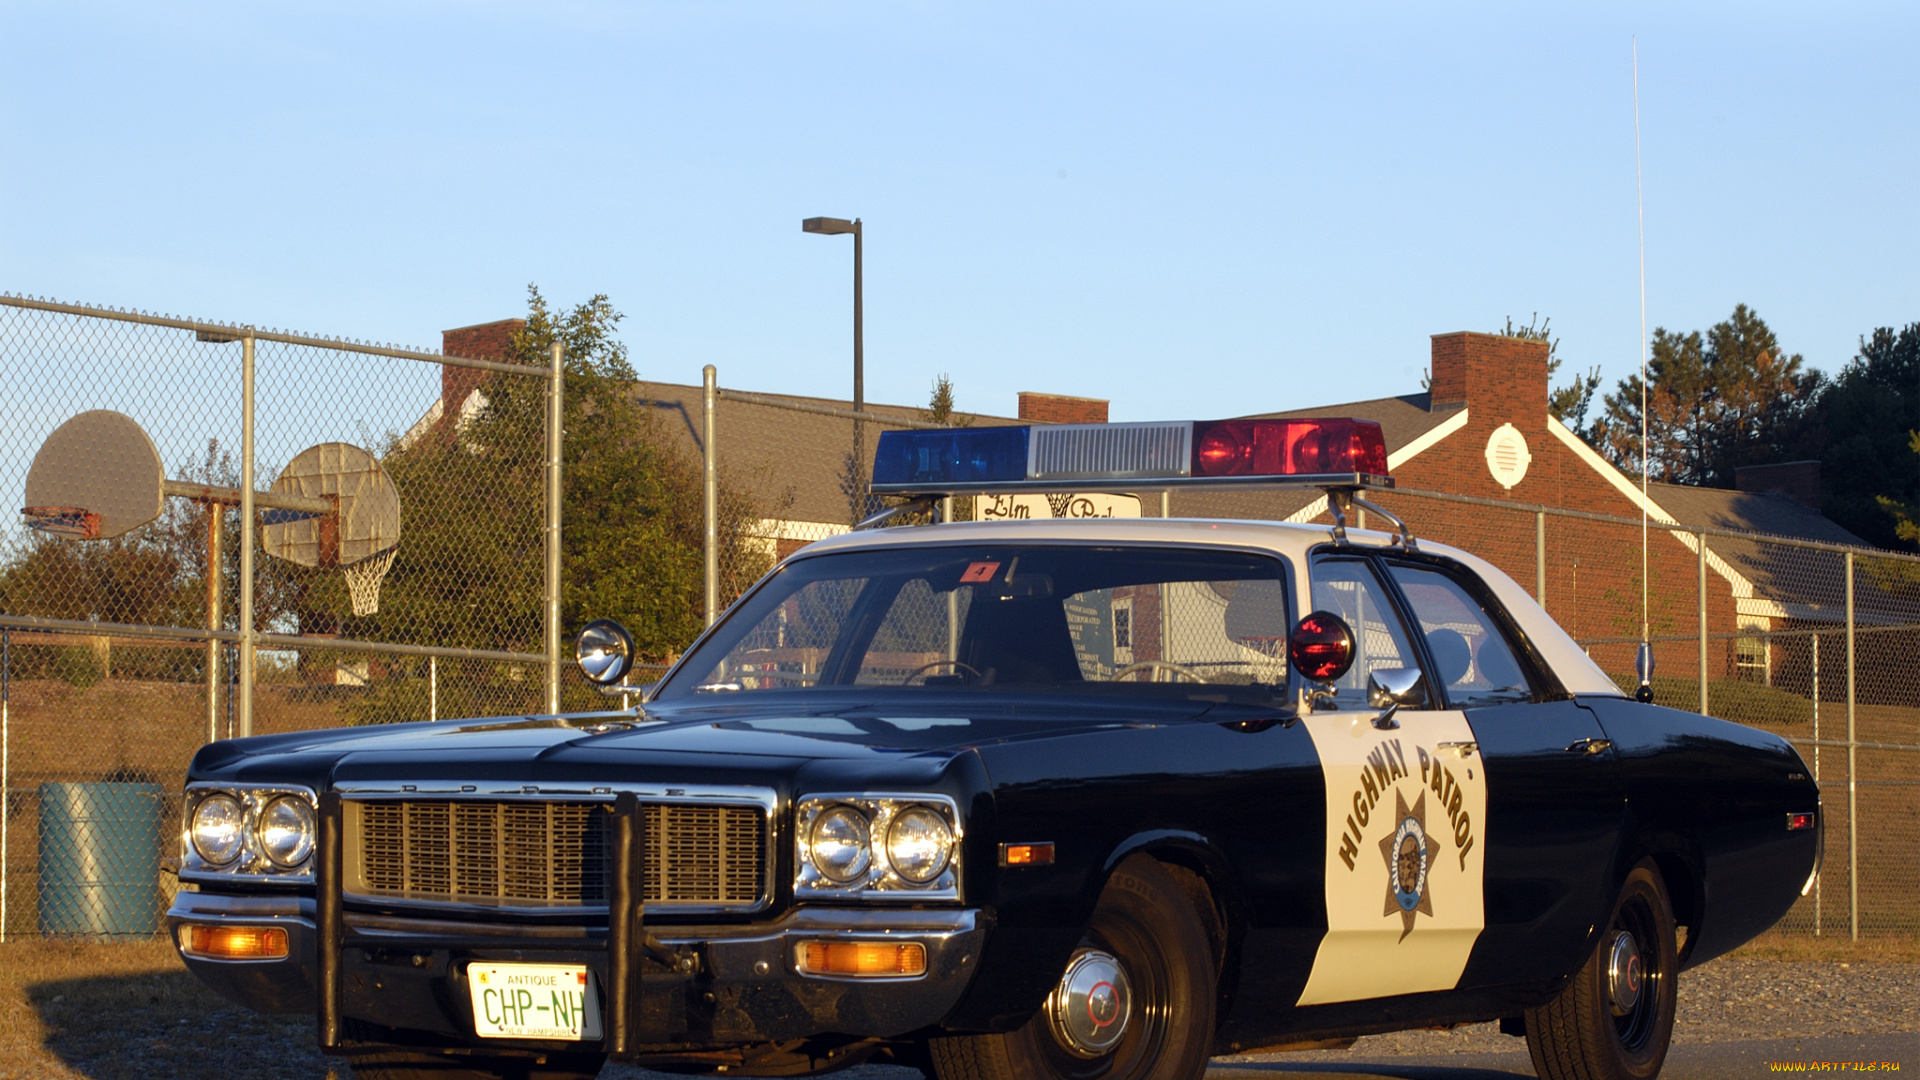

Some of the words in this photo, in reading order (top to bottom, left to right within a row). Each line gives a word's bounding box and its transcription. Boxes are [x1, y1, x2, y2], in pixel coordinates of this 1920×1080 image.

[984, 494, 1031, 520] Elm
[975, 567, 986, 576] 4
[401, 784, 686, 797] DODGE
[1338, 738, 1409, 872] HIGHWAY
[1415, 744, 1474, 873] PATROL
[507, 975, 558, 986] ANTIQUE
[483, 988, 588, 1029] CHP-NH
[505, 1027, 523, 1036] NEW
[527, 1027, 572, 1037] HAMPSHIRE
